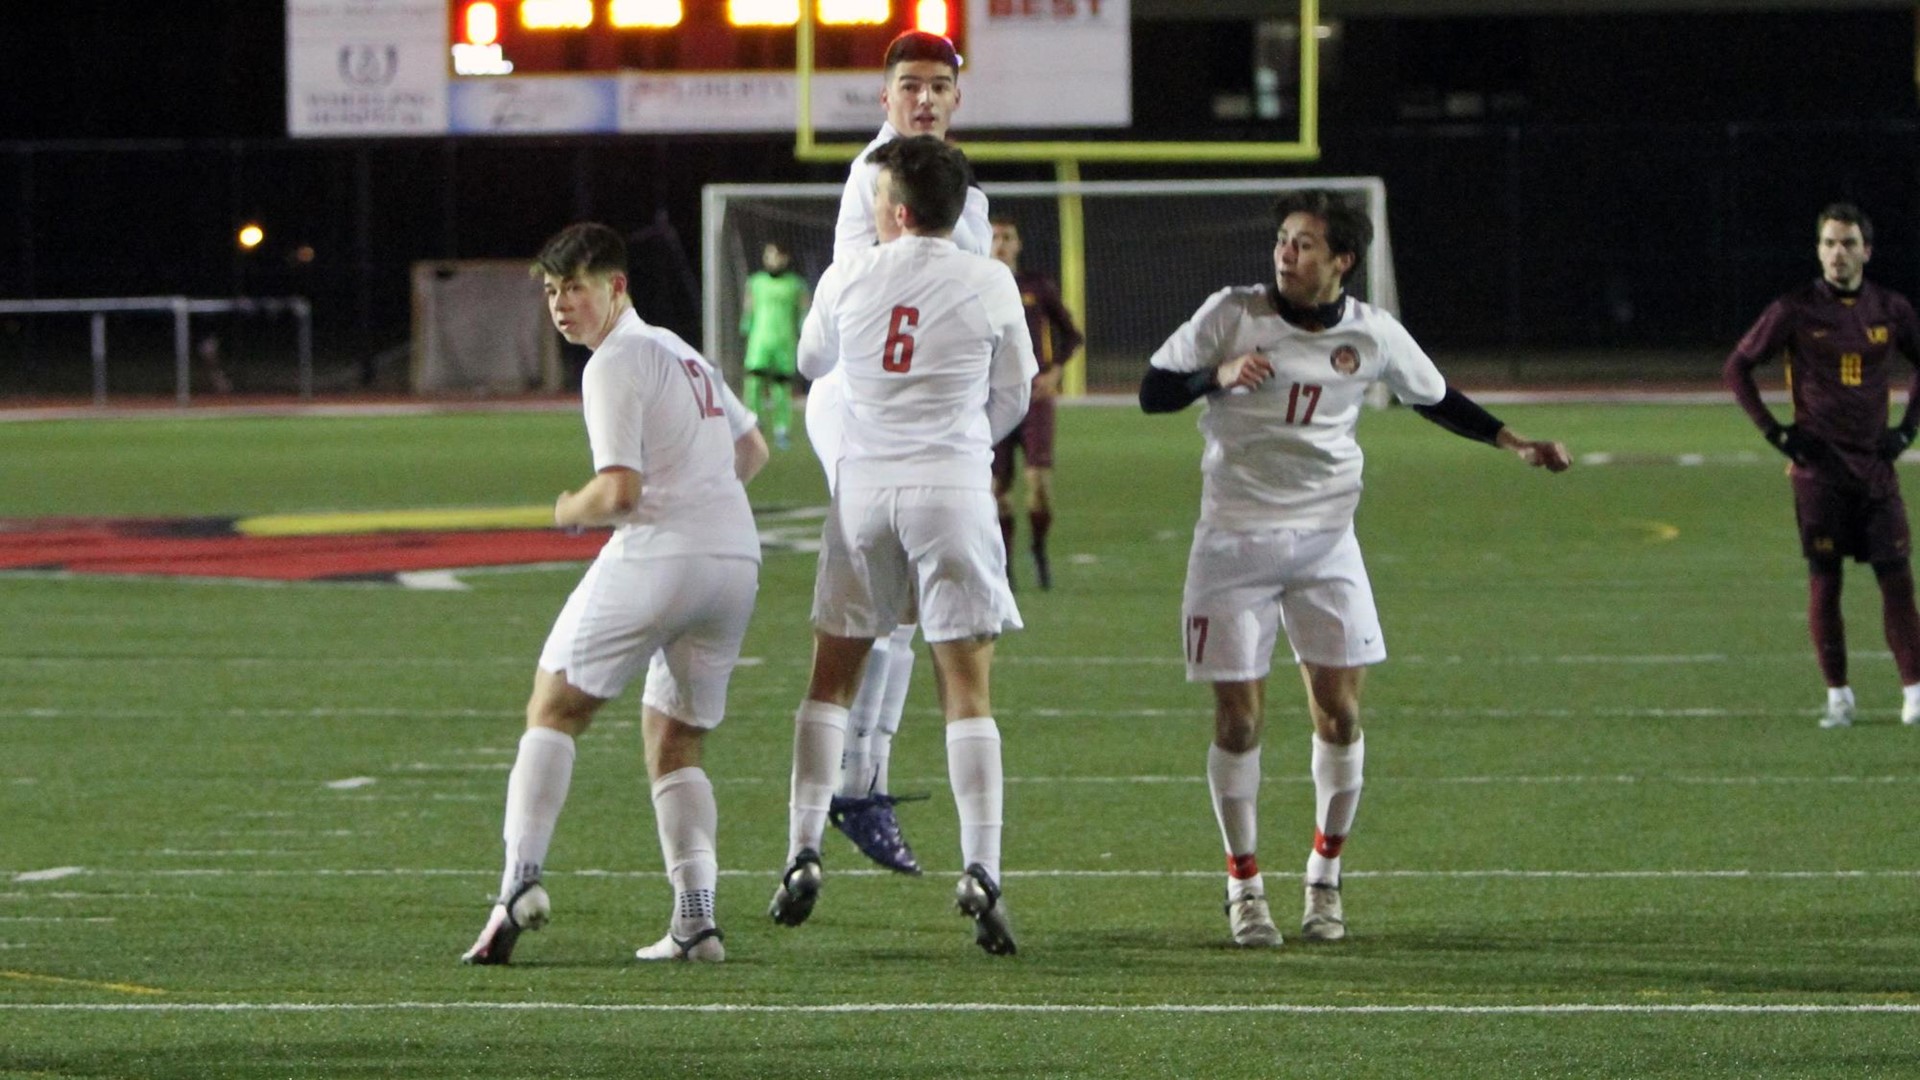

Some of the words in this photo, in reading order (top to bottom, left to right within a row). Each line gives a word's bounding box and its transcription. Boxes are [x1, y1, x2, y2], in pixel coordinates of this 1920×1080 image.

[883, 305, 919, 373] 6
[677, 357, 725, 419] 12
[1286, 382, 1322, 424] 17
[1186, 615, 1209, 664] 17
